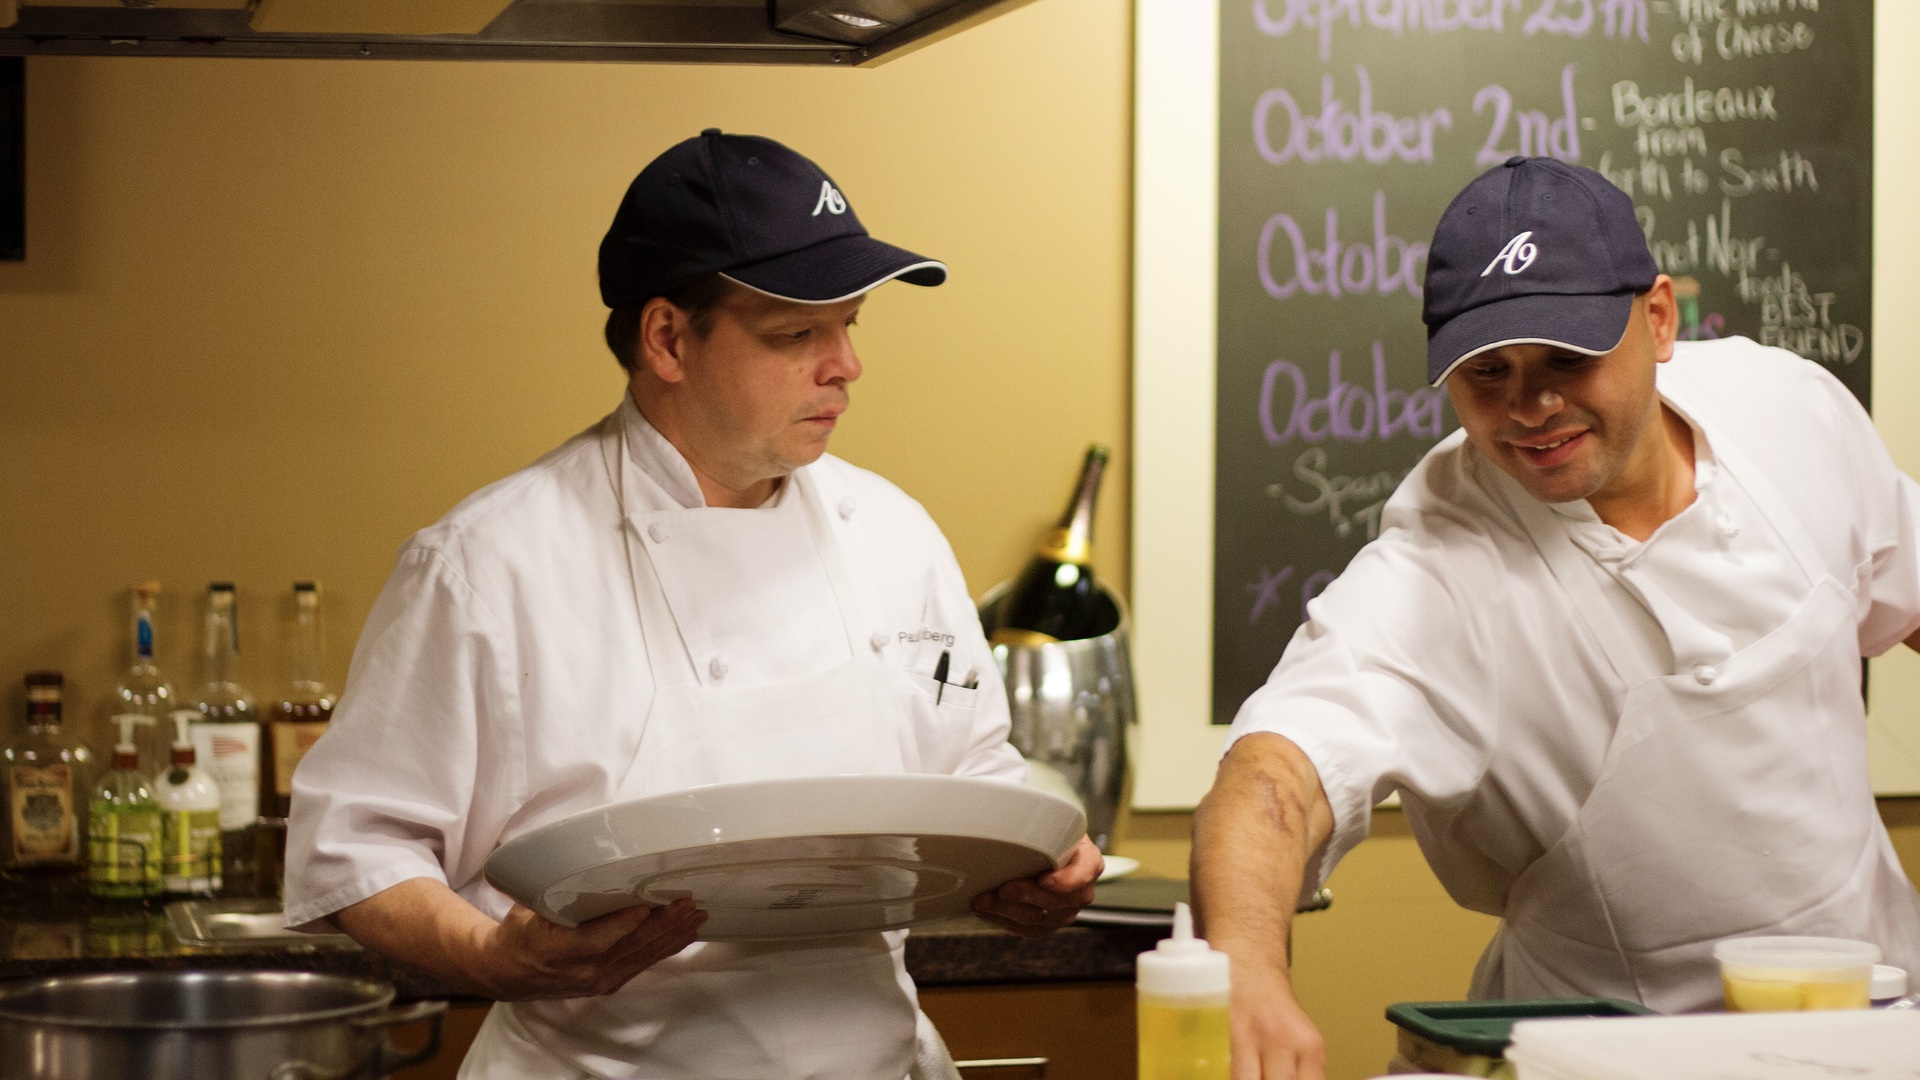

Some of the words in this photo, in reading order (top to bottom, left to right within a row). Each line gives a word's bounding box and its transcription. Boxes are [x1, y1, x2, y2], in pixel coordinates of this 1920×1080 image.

[1671, 21, 1703, 65] of
[1716, 17, 1815, 60] Cheese
[1252, 64, 1453, 165] October
[1473, 63, 1582, 166] 2nd
[1611, 76, 1778, 128] Bordeaux
[1634, 123, 1707, 159] from
[1681, 157, 1709, 194] to
[1719, 147, 1819, 197] South
[1257, 190, 1430, 299] Octobe
[1480, 230, 1537, 277] A9
[1761, 292, 1836, 330] BEST
[1760, 323, 1864, 364] FRIEND
[1258, 340, 1448, 446] October
